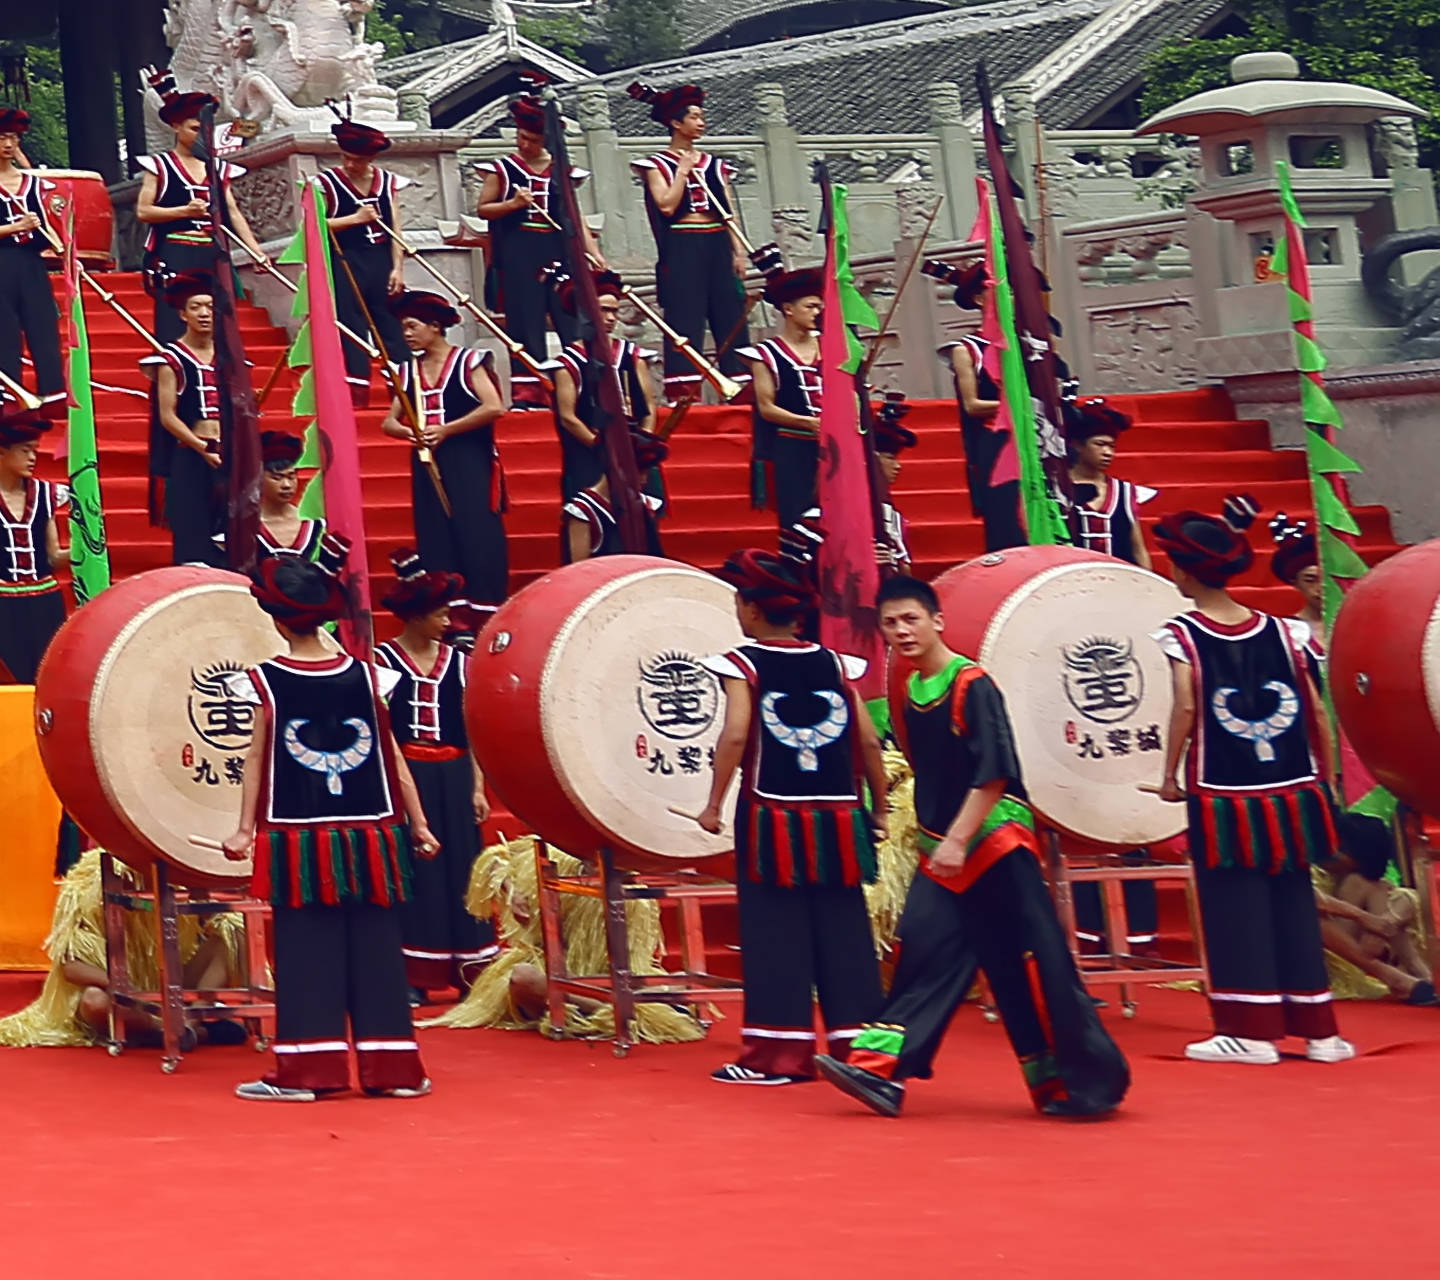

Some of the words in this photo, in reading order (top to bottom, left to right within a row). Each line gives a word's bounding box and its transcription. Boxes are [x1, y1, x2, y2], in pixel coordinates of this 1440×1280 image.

[1077, 723, 1163, 760] 九黎城
[647, 745, 717, 776] 九黎
